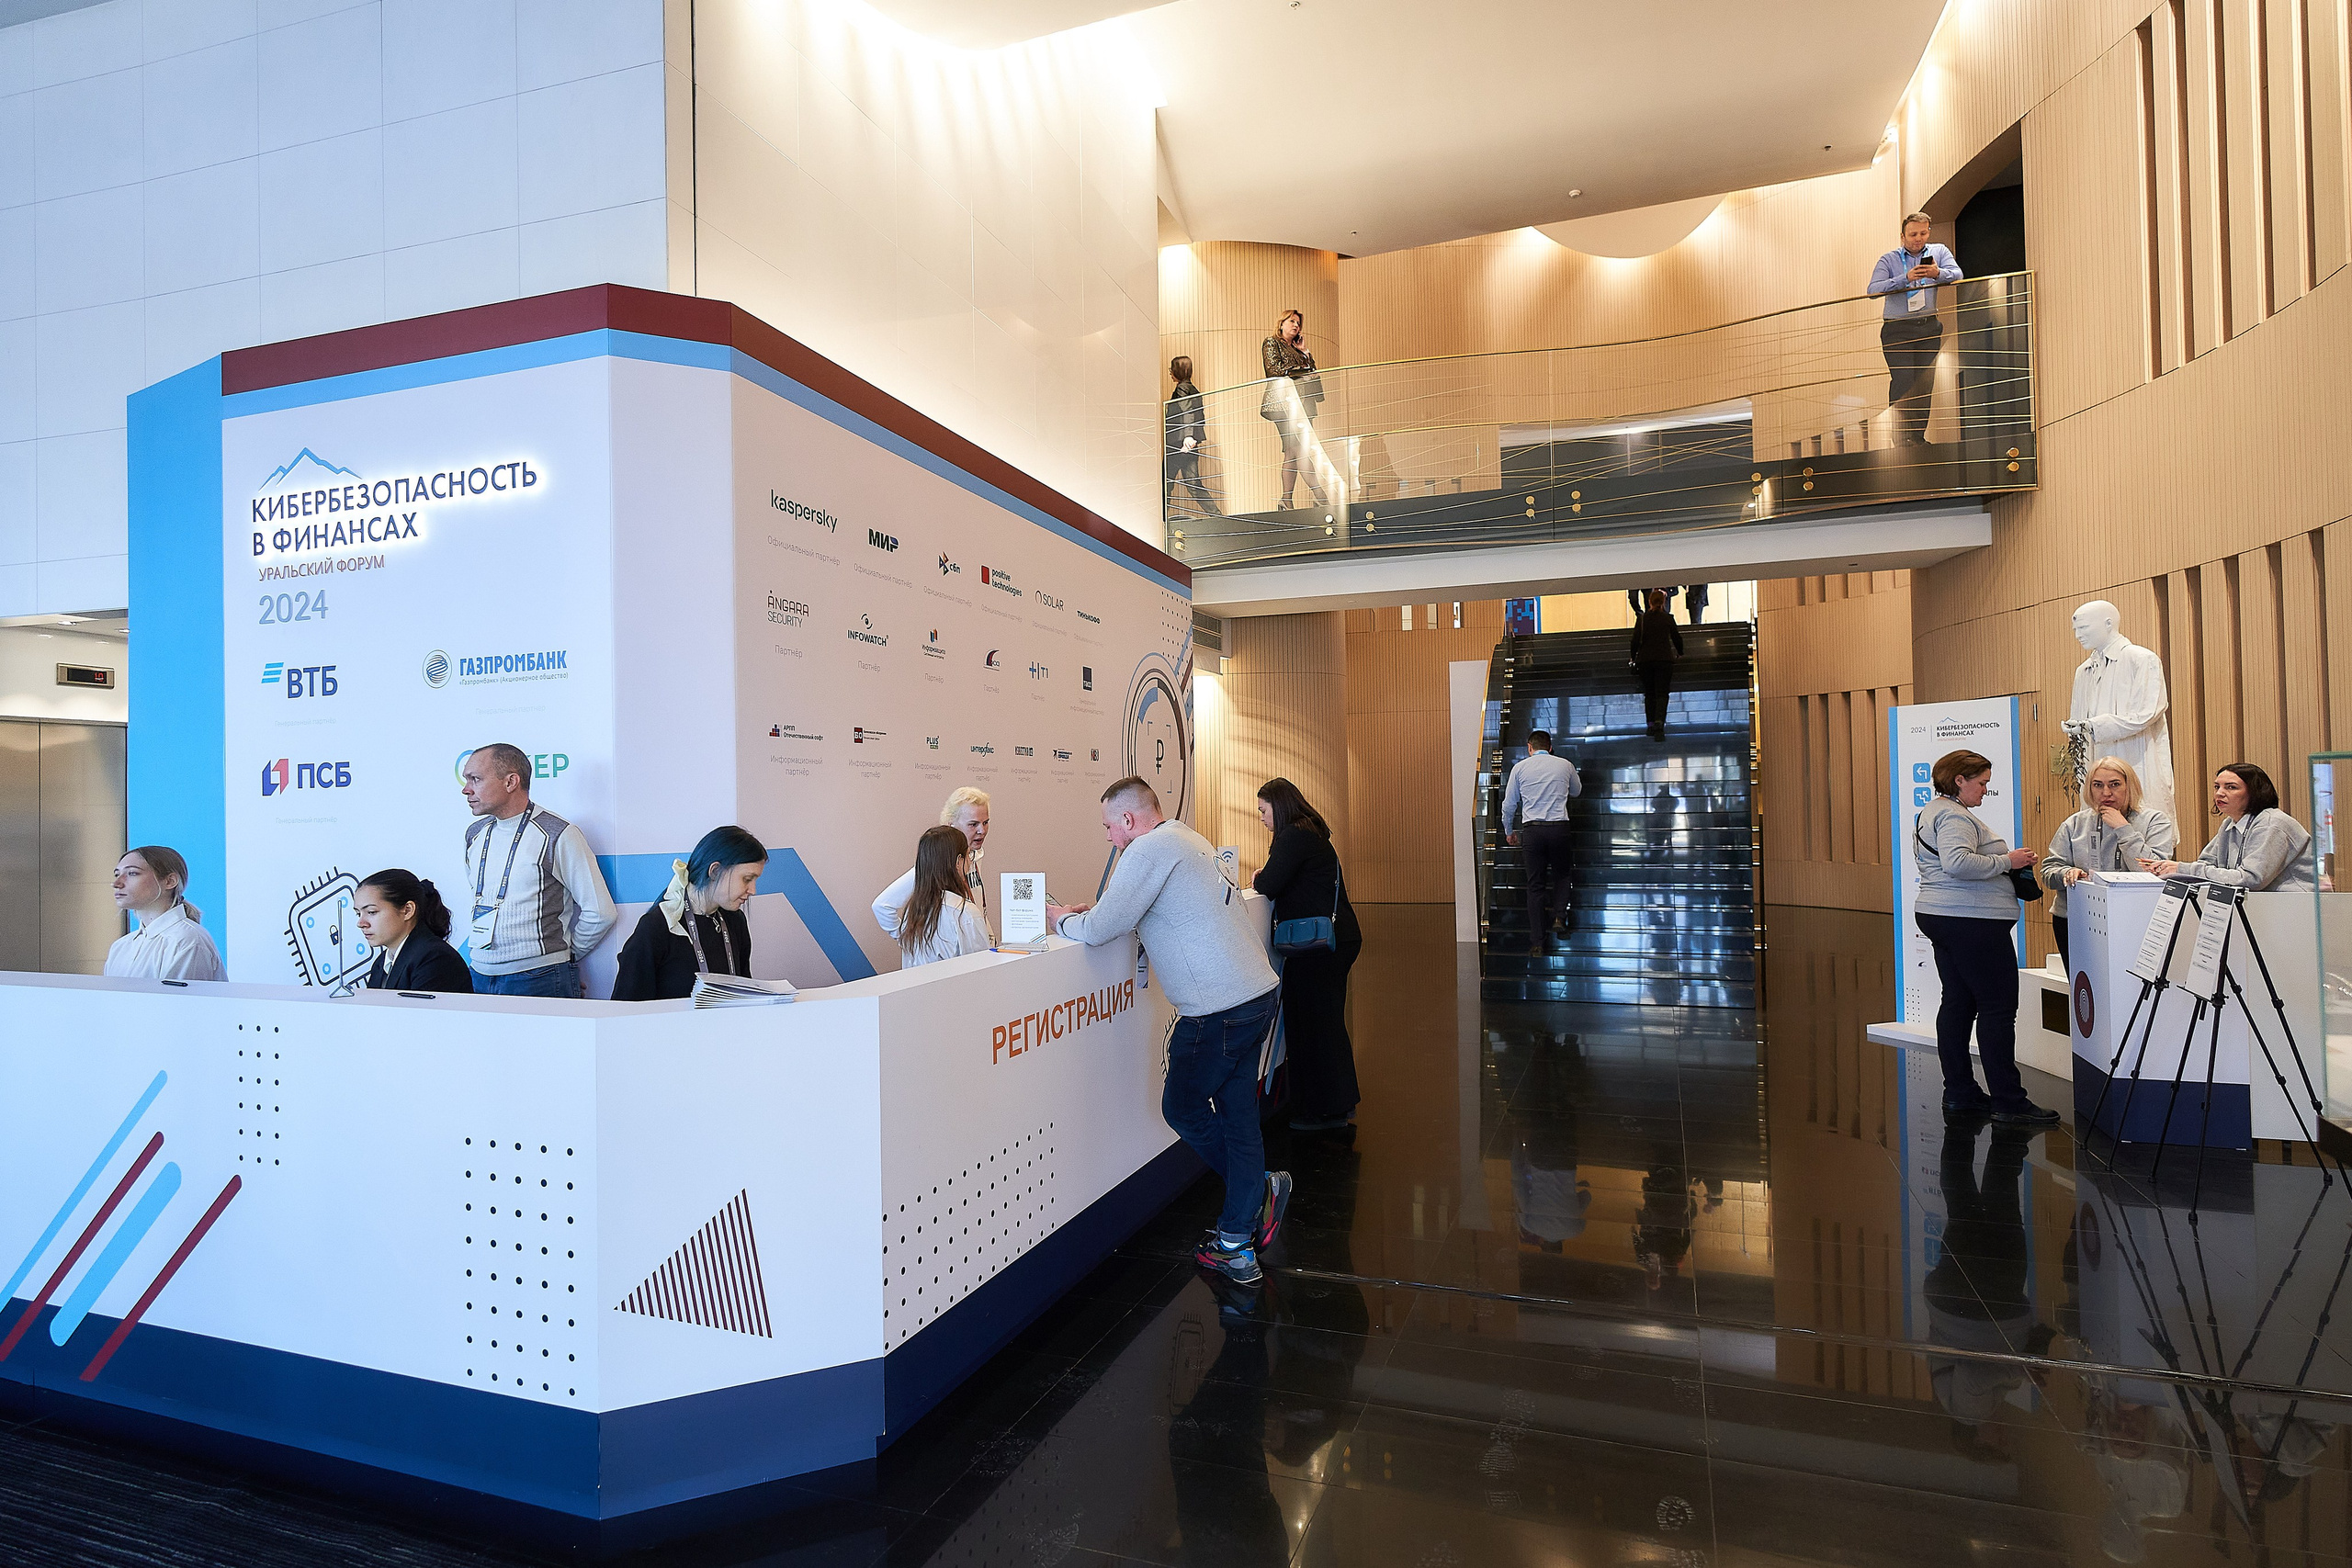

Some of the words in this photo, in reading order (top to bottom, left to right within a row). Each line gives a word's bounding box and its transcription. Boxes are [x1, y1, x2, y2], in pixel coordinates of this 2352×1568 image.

[252, 461, 537, 523] КИБЕРБЕЗОПАСНОСТЬ
[771, 489, 838, 534] kaspersky
[254, 532, 266, 556] В
[273, 512, 419, 553] ФИНАНСАХ
[868, 527, 899, 552] МИР
[767, 535, 815, 558] Официальный
[815, 550, 841, 567] партнёр
[258, 557, 334, 581] УРАЛЬСКИЙ
[336, 555, 386, 574] ФОРУМ
[949, 562, 961, 574] сбп
[992, 569, 1011, 582] positive
[992, 579, 1023, 597] technologies
[258, 590, 330, 625] 2024
[1043, 593, 1064, 611] SOLAR
[767, 611, 803, 628] SECURITY
[775, 644, 803, 660] Партнёр
[459, 650, 567, 676] ГАЗПРОМБАНК
[857, 660, 881, 674] Партнёр
[287, 665, 338, 699] ВТБ
[459, 677, 499, 686] «Газпромбанк»
[500, 674, 538, 684] (Акционерное
[539, 671, 569, 682] общество)
[783, 731, 815, 740] Отечественный
[1936, 722, 2000, 732] КИБЕРБЕЗОПАСНОСТЬ
[770, 754, 823, 766] Информационный
[298, 761, 352, 788] ПСБ
[785, 768, 810, 777] партнёр
[992, 977, 1134, 1066] РЕГИСТРАЦИЯ
